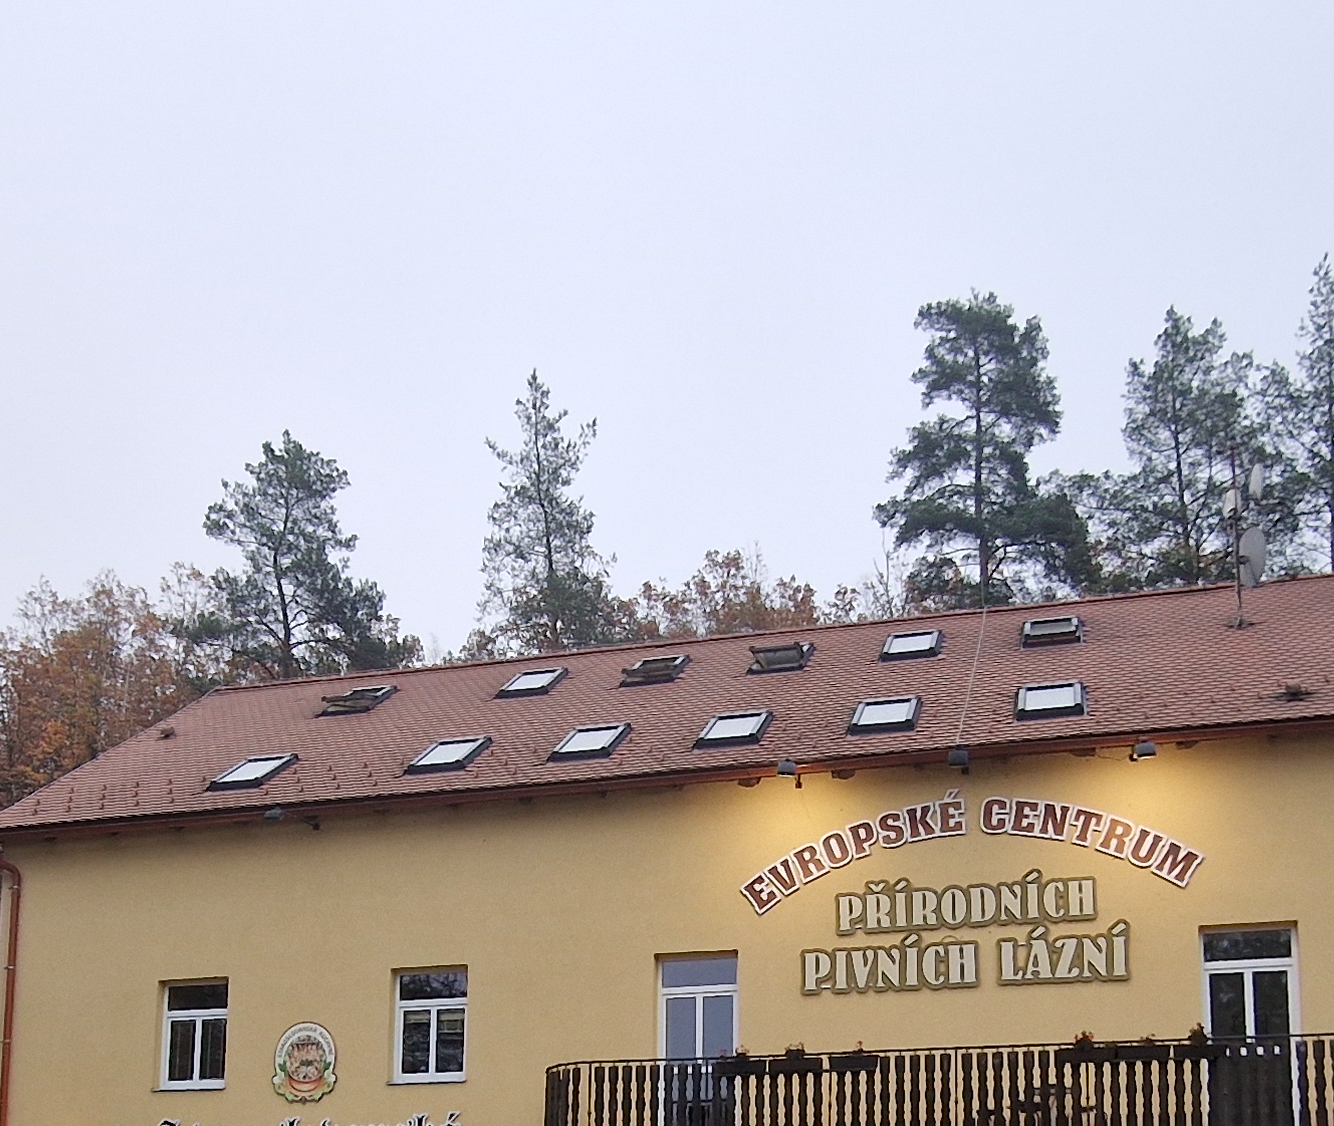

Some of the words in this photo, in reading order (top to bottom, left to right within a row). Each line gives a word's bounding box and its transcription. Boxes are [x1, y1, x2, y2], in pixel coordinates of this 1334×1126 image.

[740, 789, 966, 915] EVROPSKÉ
[980, 797, 1204, 888] CENTRUM
[837, 872, 1096, 933] PŘÍRODNÍCH
[803, 933, 978, 991] PIVNÍCH
[999, 921, 1130, 982] LÁZNÍ
